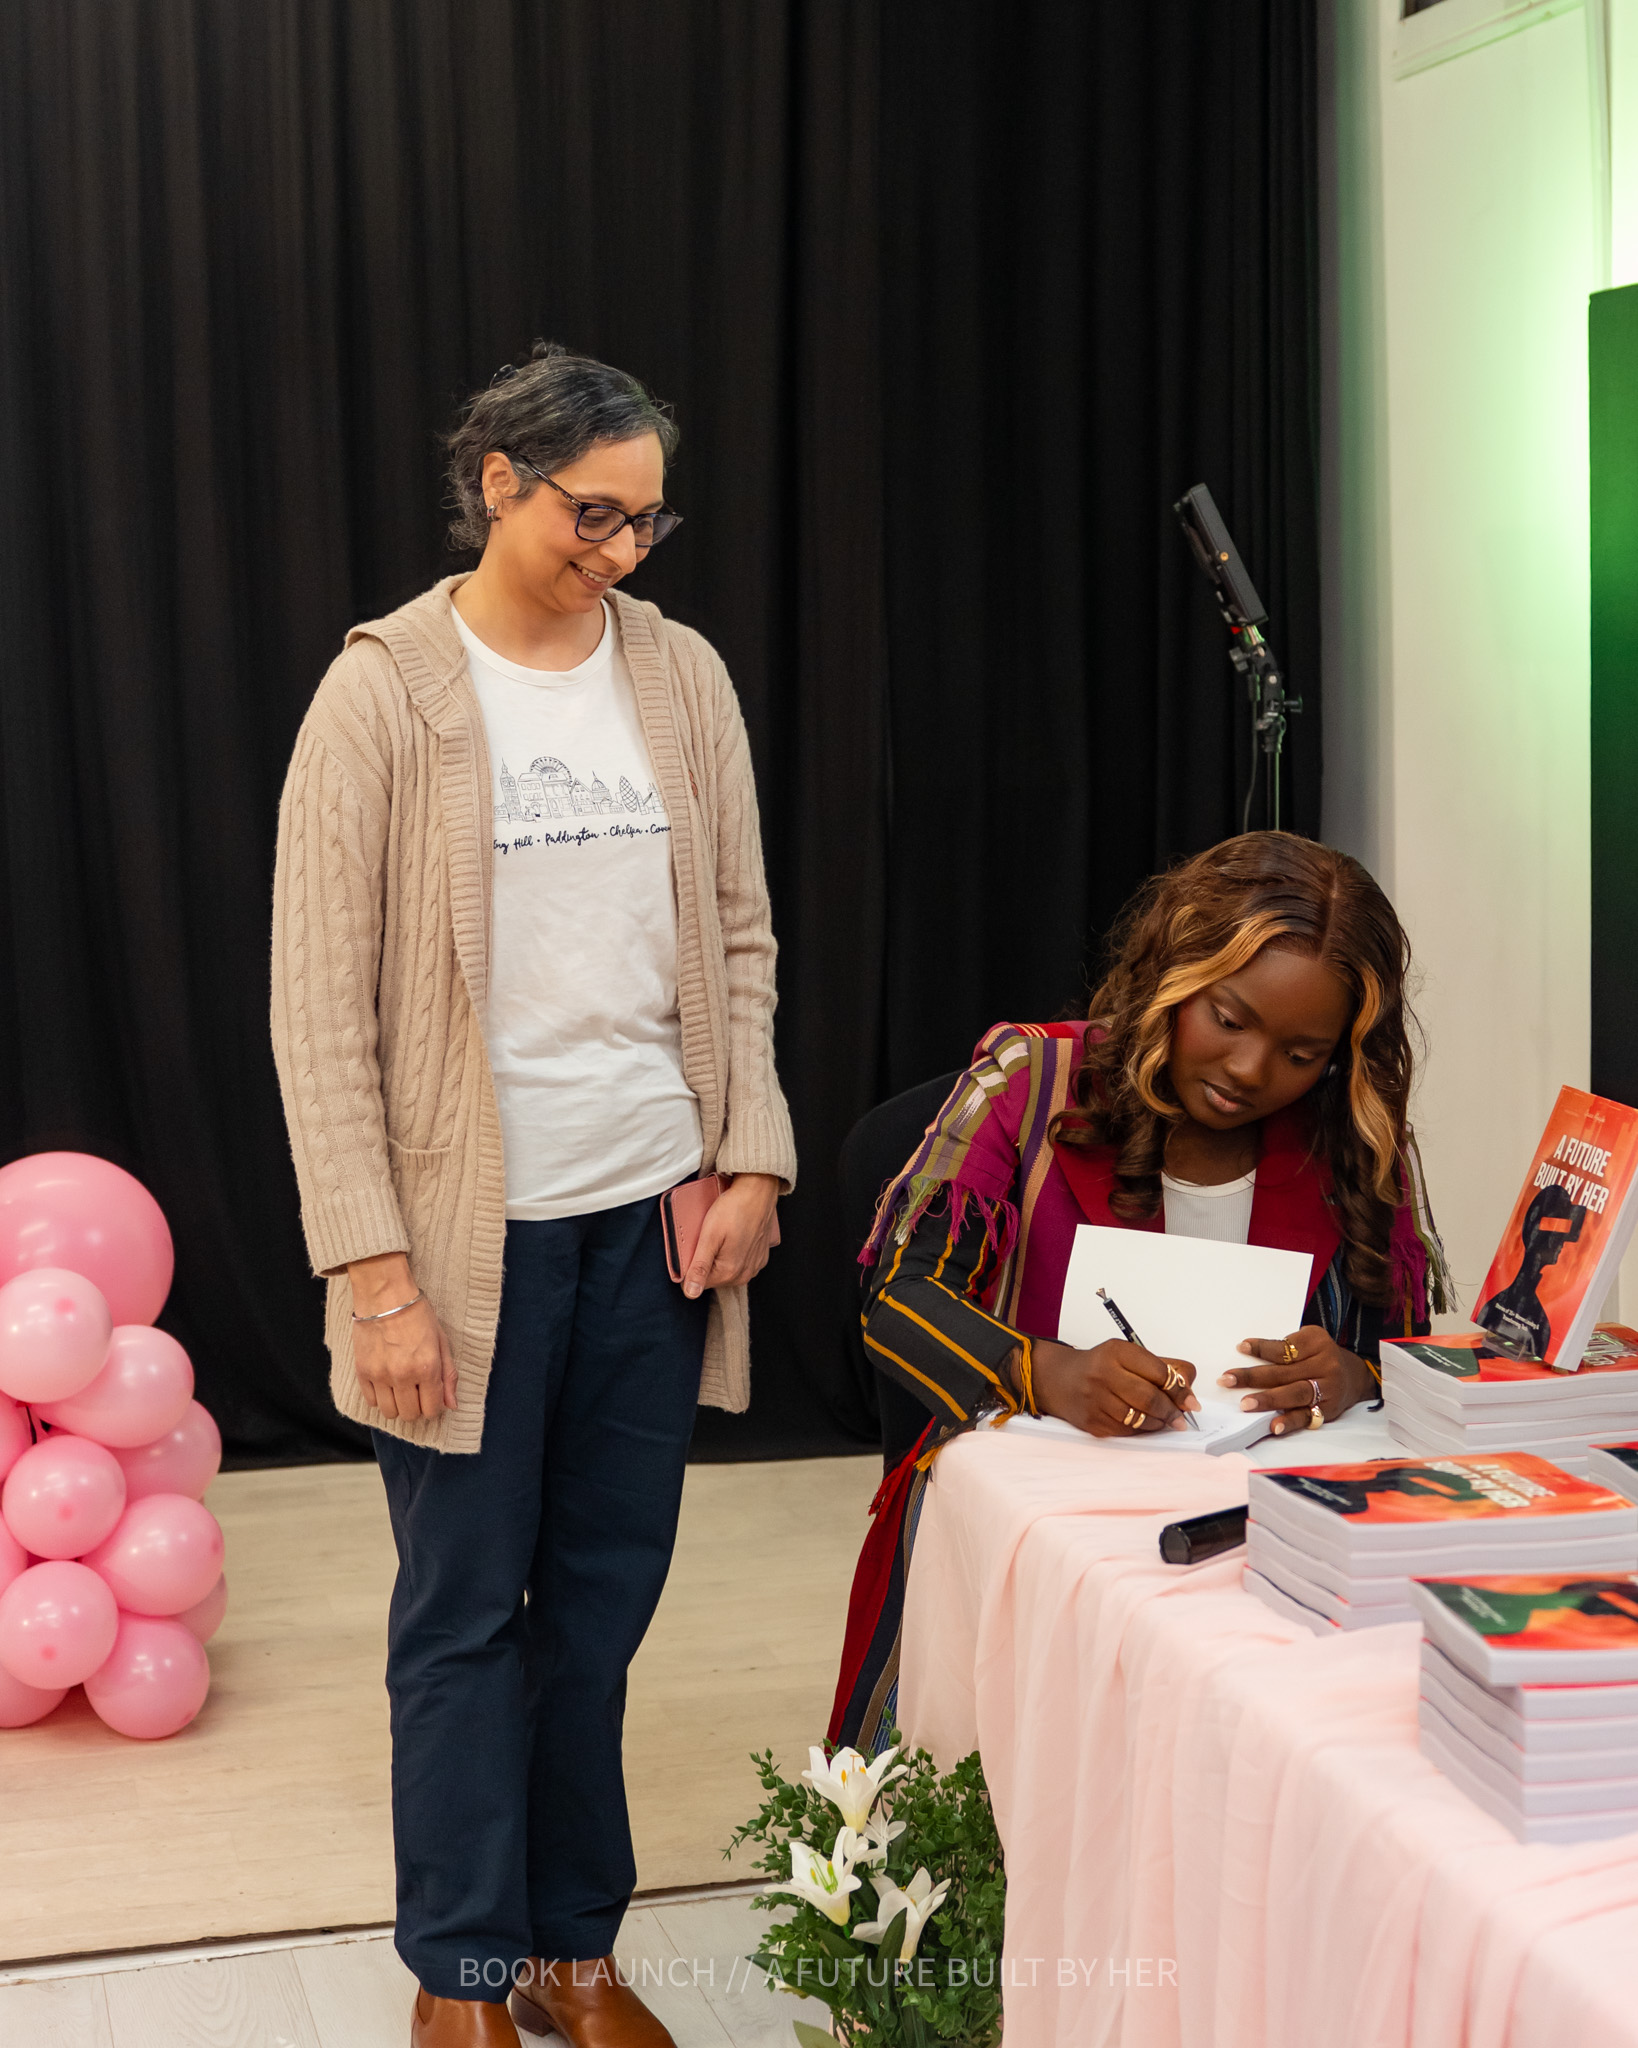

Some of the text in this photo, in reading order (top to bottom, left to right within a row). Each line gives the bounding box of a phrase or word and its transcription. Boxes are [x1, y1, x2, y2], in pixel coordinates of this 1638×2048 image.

[493, 839, 509, 855] ing
[513, 835, 533, 850] Hill
[545, 827, 599, 846] Paddington
[609, 823, 643, 838] Chelsea
[1553, 1134, 1612, 1178] A FUTURE
[1565, 1173, 1584, 1202] BY
[1578, 1180, 1610, 1215] HER
